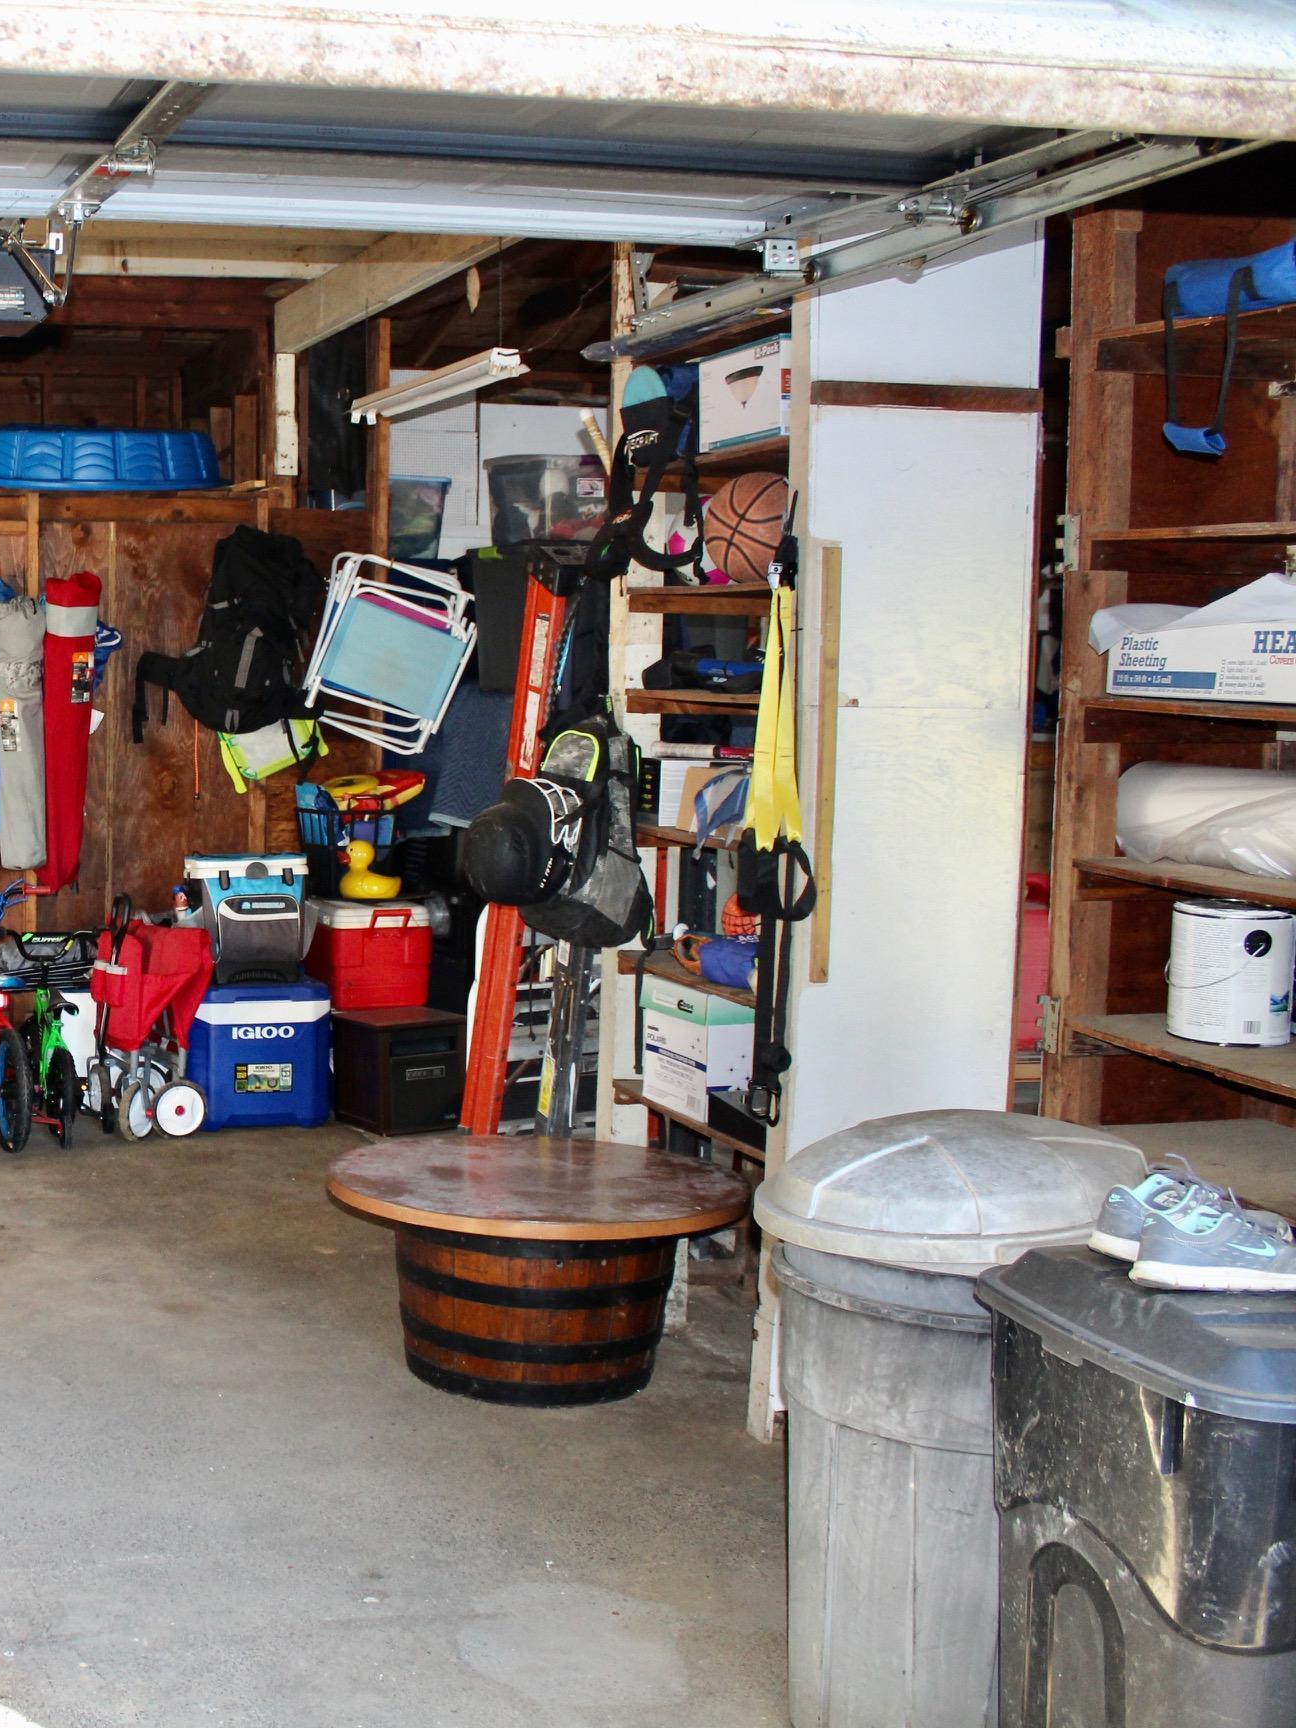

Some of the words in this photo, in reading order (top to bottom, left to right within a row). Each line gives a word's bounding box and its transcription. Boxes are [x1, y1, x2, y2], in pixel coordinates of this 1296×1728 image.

[1120, 637, 1159, 651] Plastic
[1119, 652, 1168, 671] Sheeting
[231, 1025, 295, 1040] IGLOO
